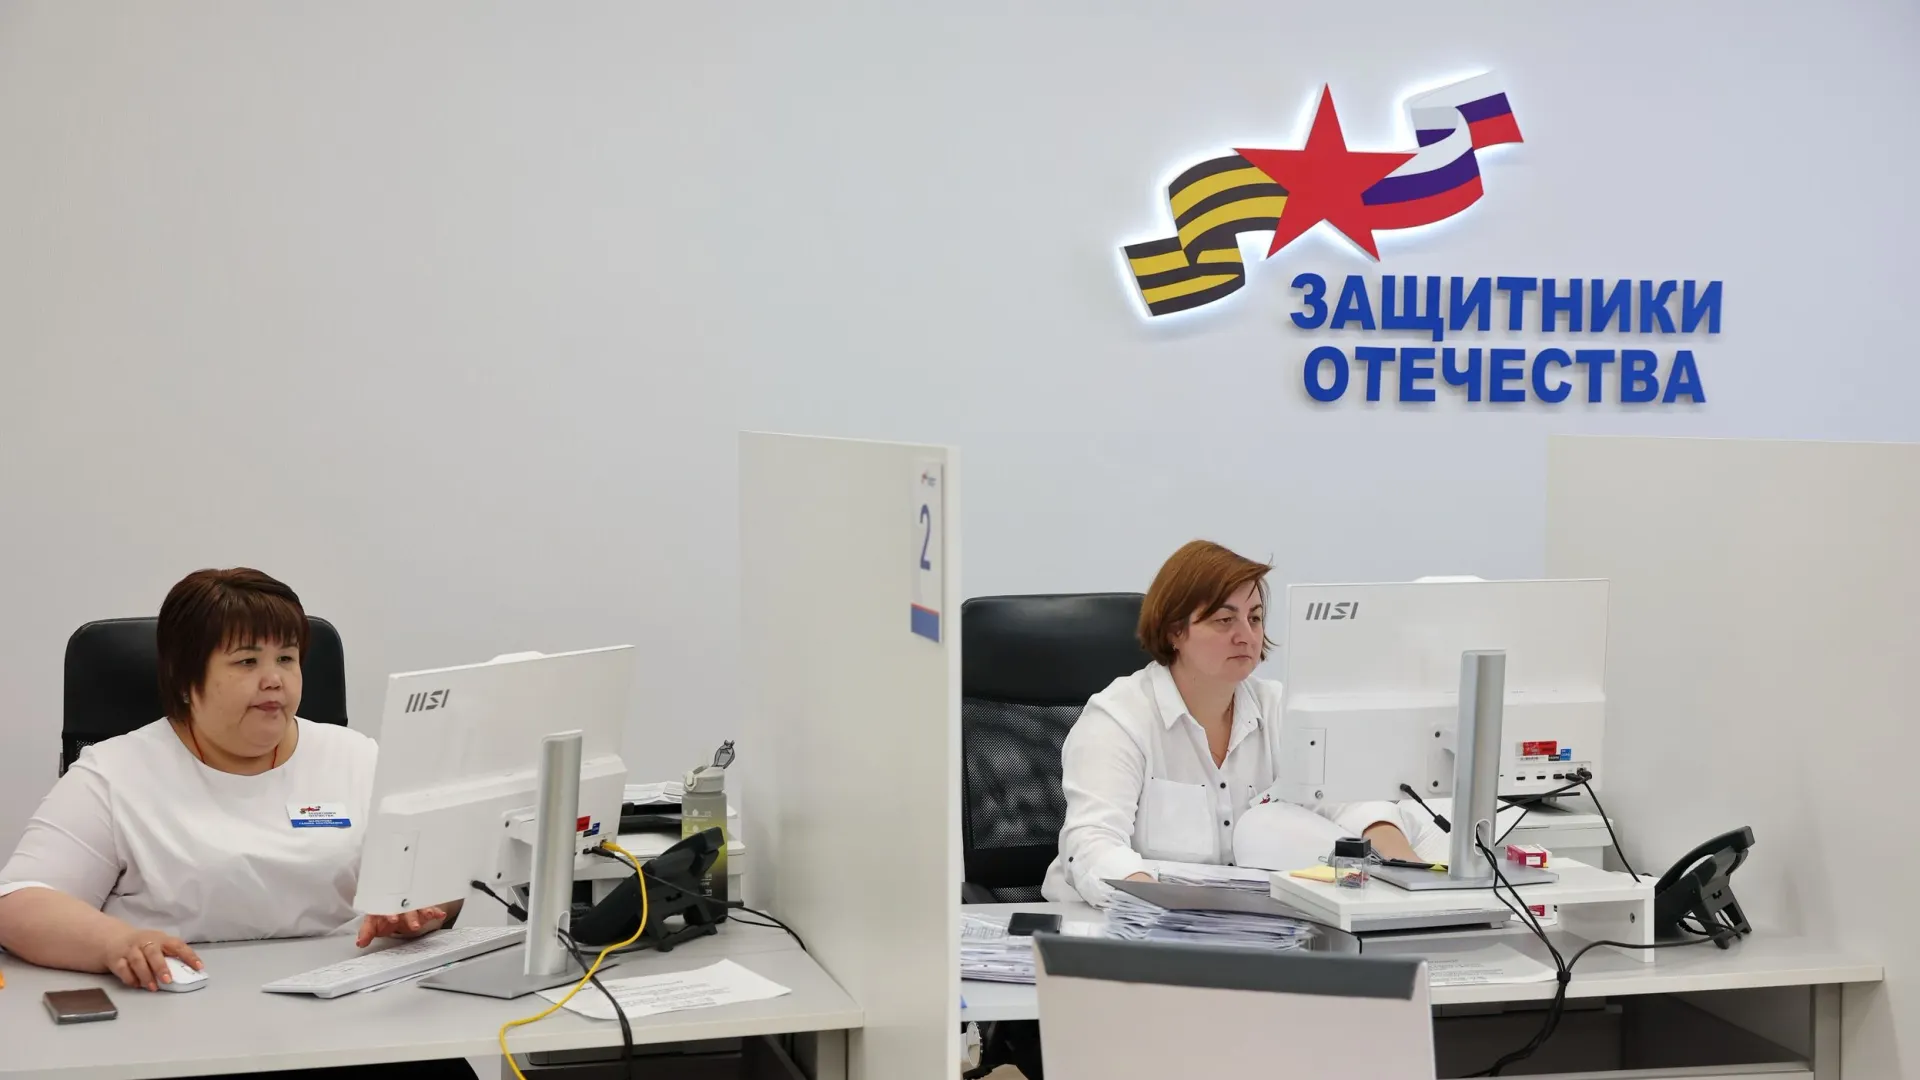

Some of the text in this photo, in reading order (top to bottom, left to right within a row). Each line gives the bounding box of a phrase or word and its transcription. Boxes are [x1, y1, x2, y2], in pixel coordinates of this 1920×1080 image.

[1290, 273, 1723, 341] ЗАЩИТНИКИ
[1303, 346, 1706, 403] ОТЕЧЕСТВА
[919, 504, 932, 571] 2
